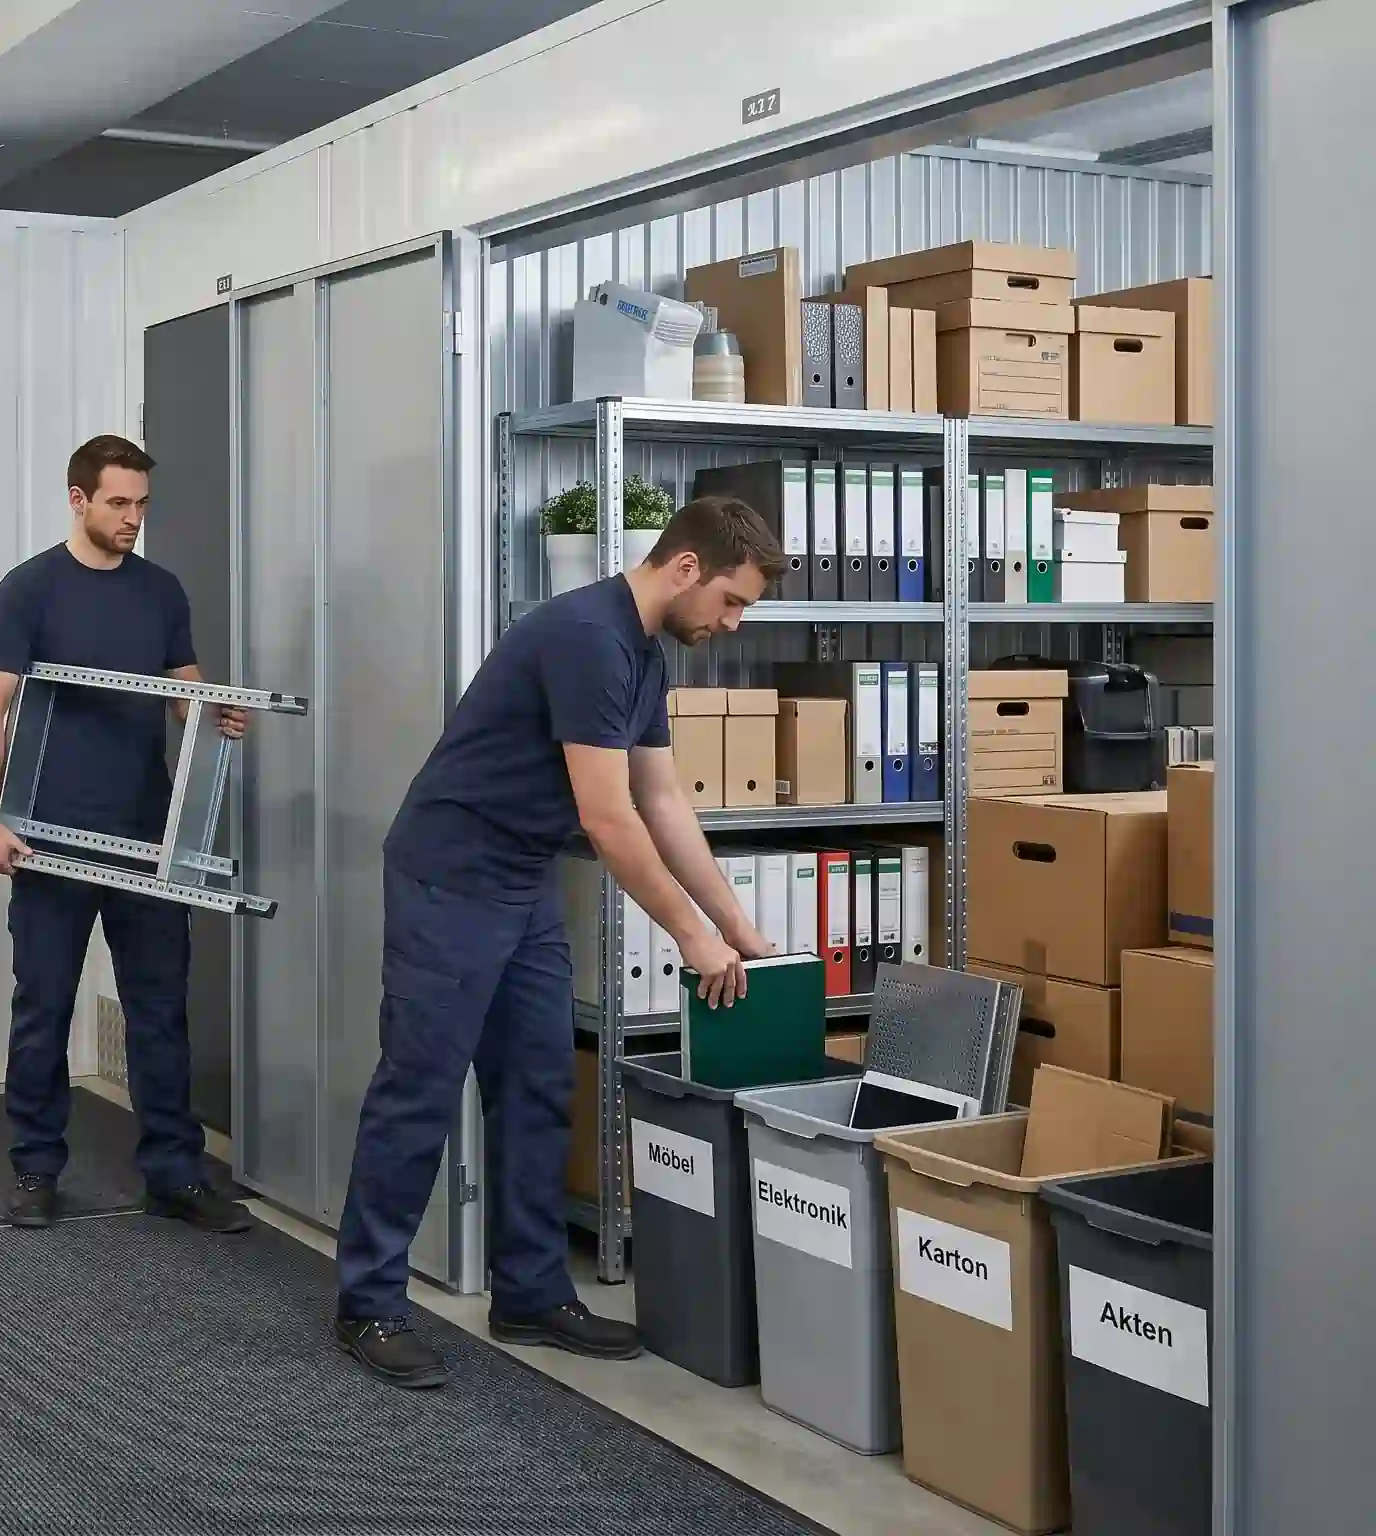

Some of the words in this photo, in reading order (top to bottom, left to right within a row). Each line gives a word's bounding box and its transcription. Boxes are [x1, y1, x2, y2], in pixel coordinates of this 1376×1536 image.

[648, 1141, 695, 1176] Möbel
[758, 1179, 847, 1229] Elektronik
[918, 1235, 988, 1281] Karton
[1099, 1301, 1173, 1348] Akten
